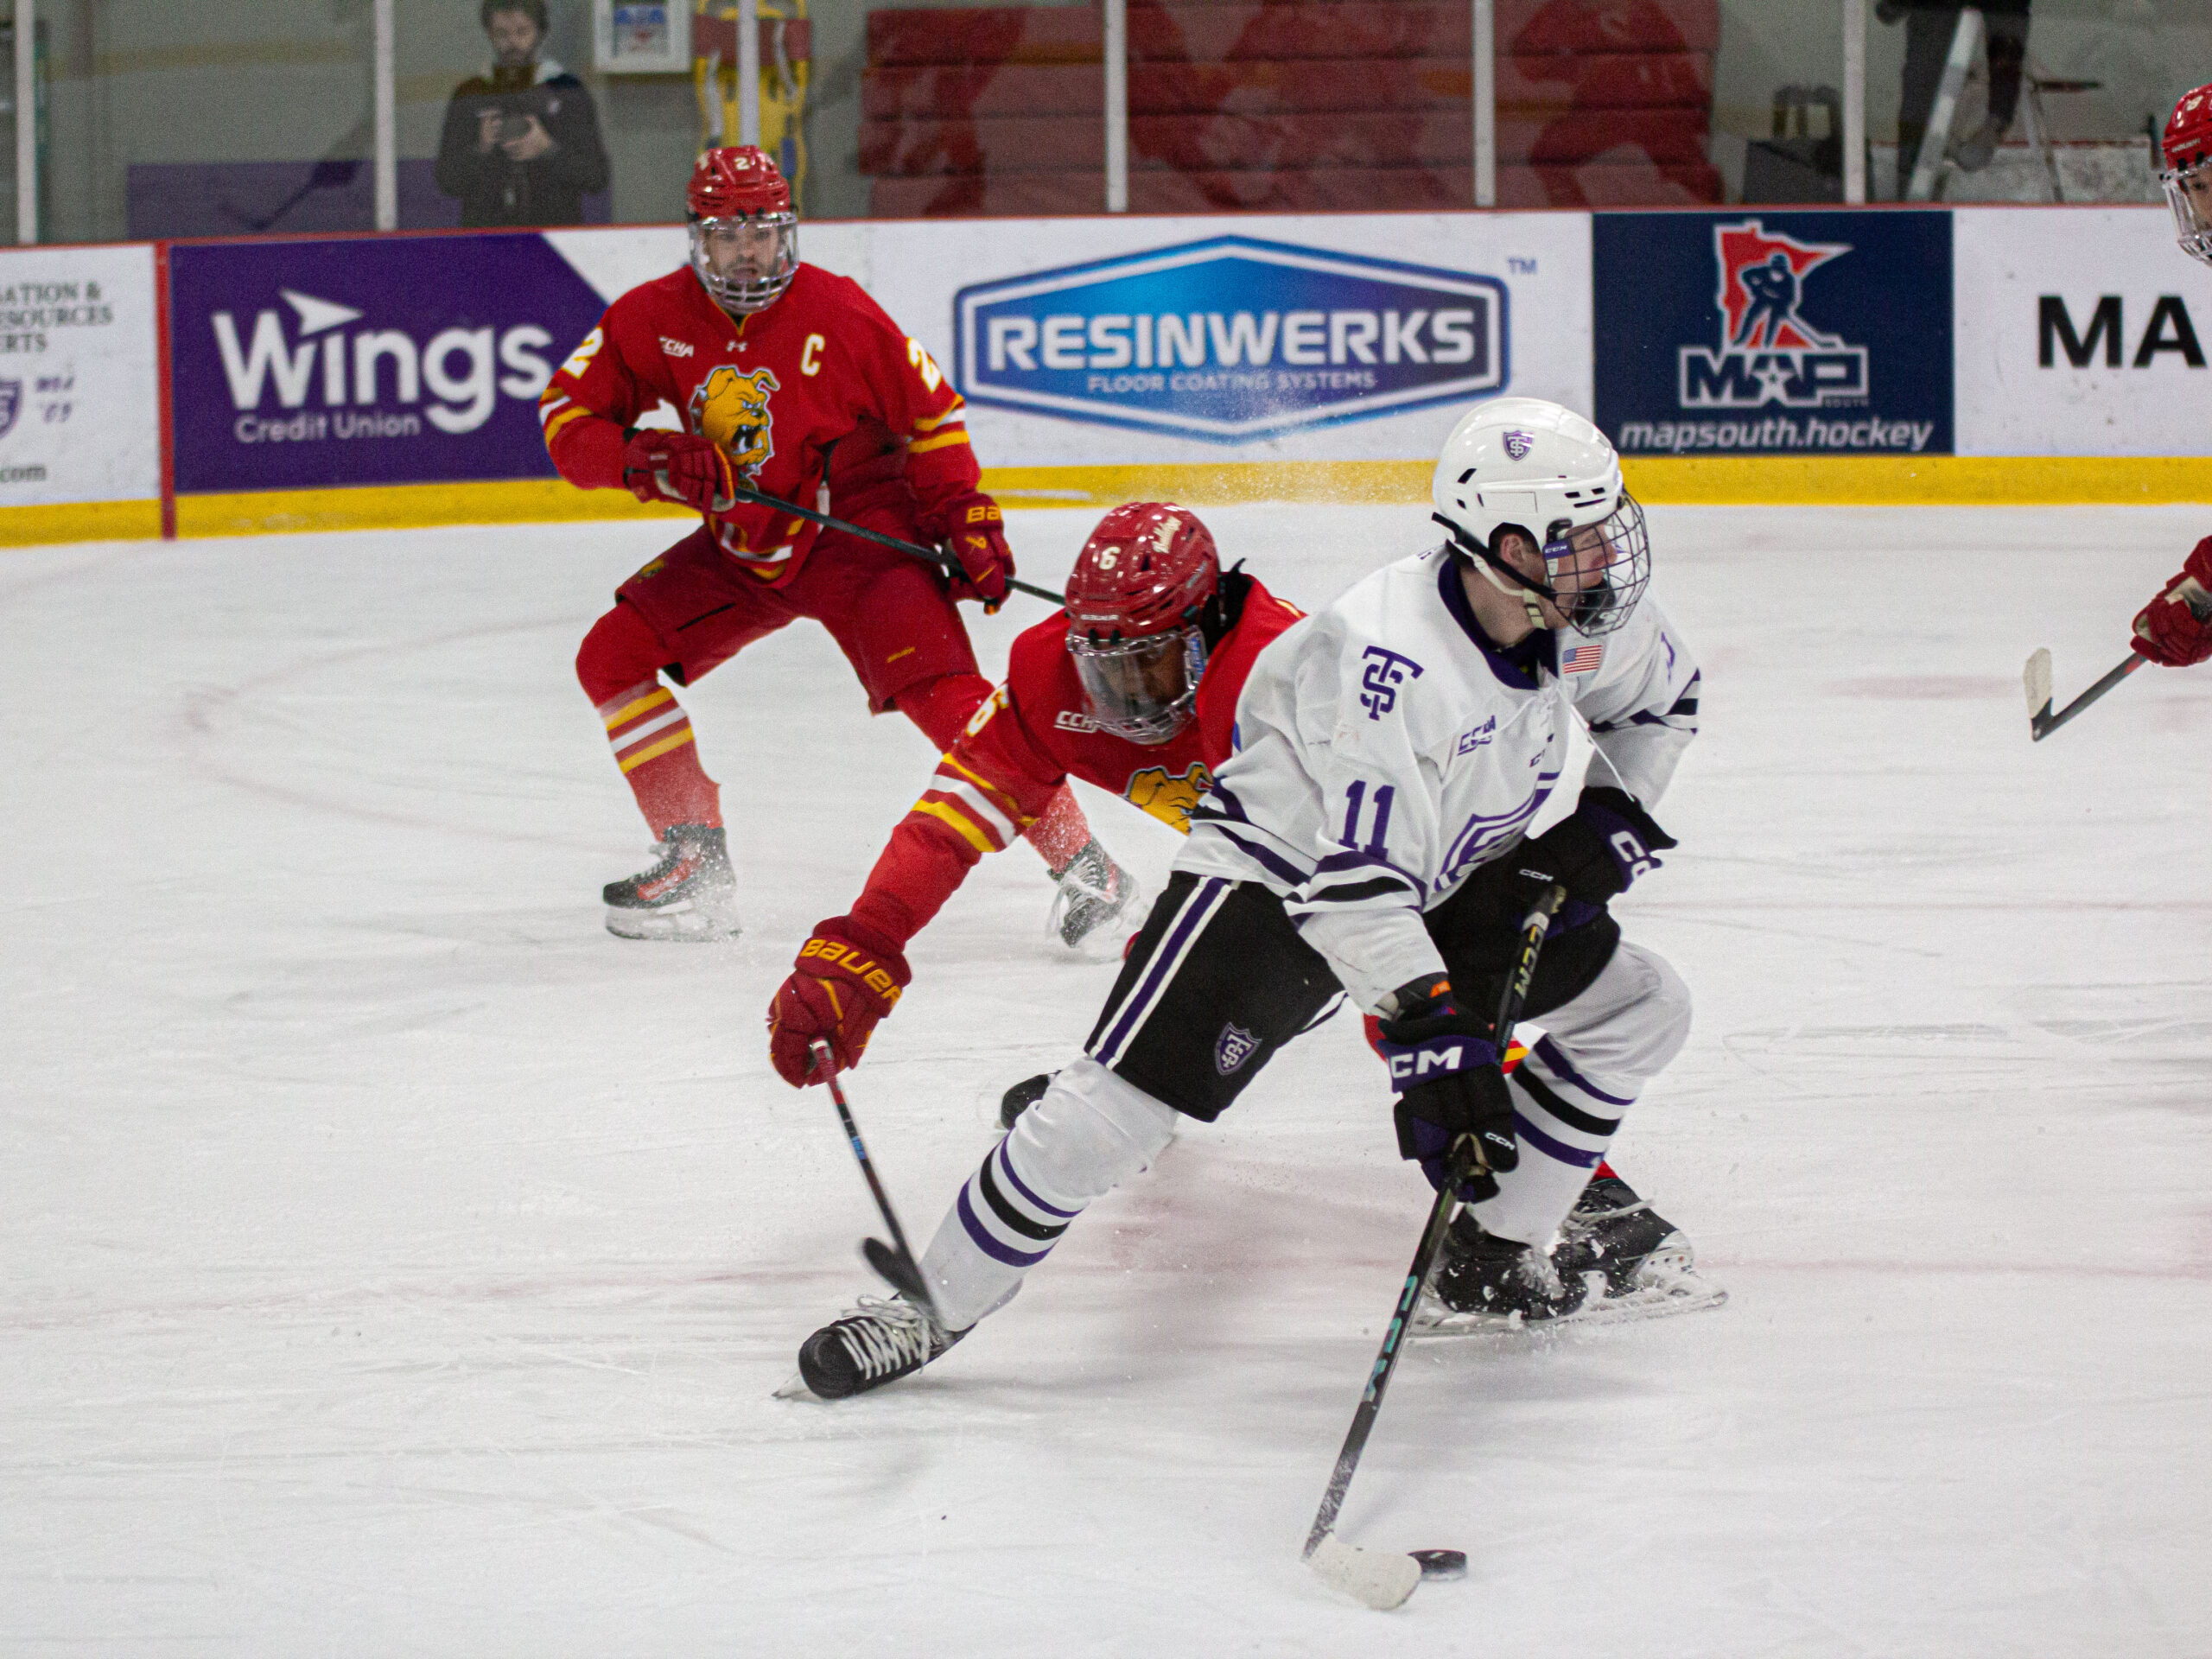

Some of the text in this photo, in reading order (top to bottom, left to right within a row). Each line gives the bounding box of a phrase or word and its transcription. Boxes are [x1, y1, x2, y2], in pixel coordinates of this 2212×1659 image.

[734, 156, 752, 170] 2
[1509, 258, 1537, 275] TM
[987, 308, 1476, 372] RESINWERKS
[2037, 295, 2208, 369] MA
[212, 289, 554, 434] Wings
[800, 332, 826, 378] C
[1087, 370, 1376, 392] FLOOR COATING SYSTEMS
[1680, 346, 1869, 408] MAP
[236, 410, 422, 443] Credit Union
[1618, 417, 1934, 454] mapsouth.hockey
[1098, 545, 1122, 570] 6
[1338, 779, 1395, 861] 11
[1518, 868, 1554, 882] CCM
[1514, 925, 1544, 1001] CCM
